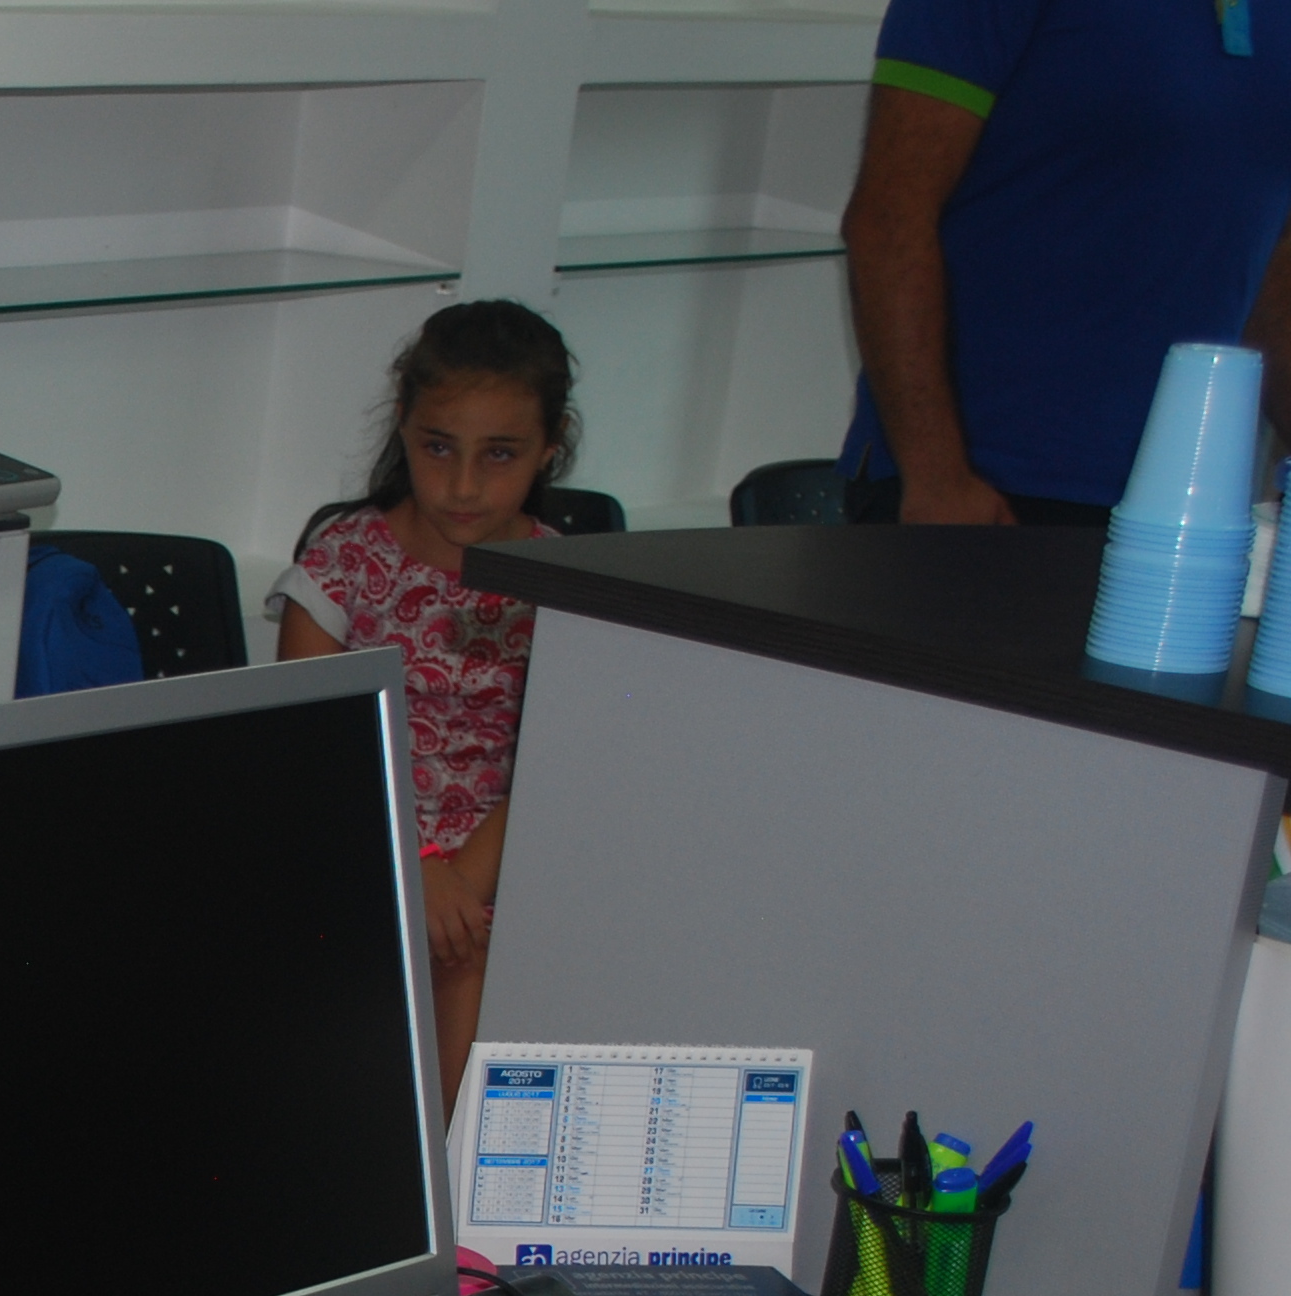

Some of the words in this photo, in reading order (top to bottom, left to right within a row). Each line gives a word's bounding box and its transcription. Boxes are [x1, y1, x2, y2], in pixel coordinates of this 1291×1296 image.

[500, 1069, 542, 1078] AGOSTO
[555, 1247, 640, 1266] agenzia
[648, 1247, 732, 1266] principe
